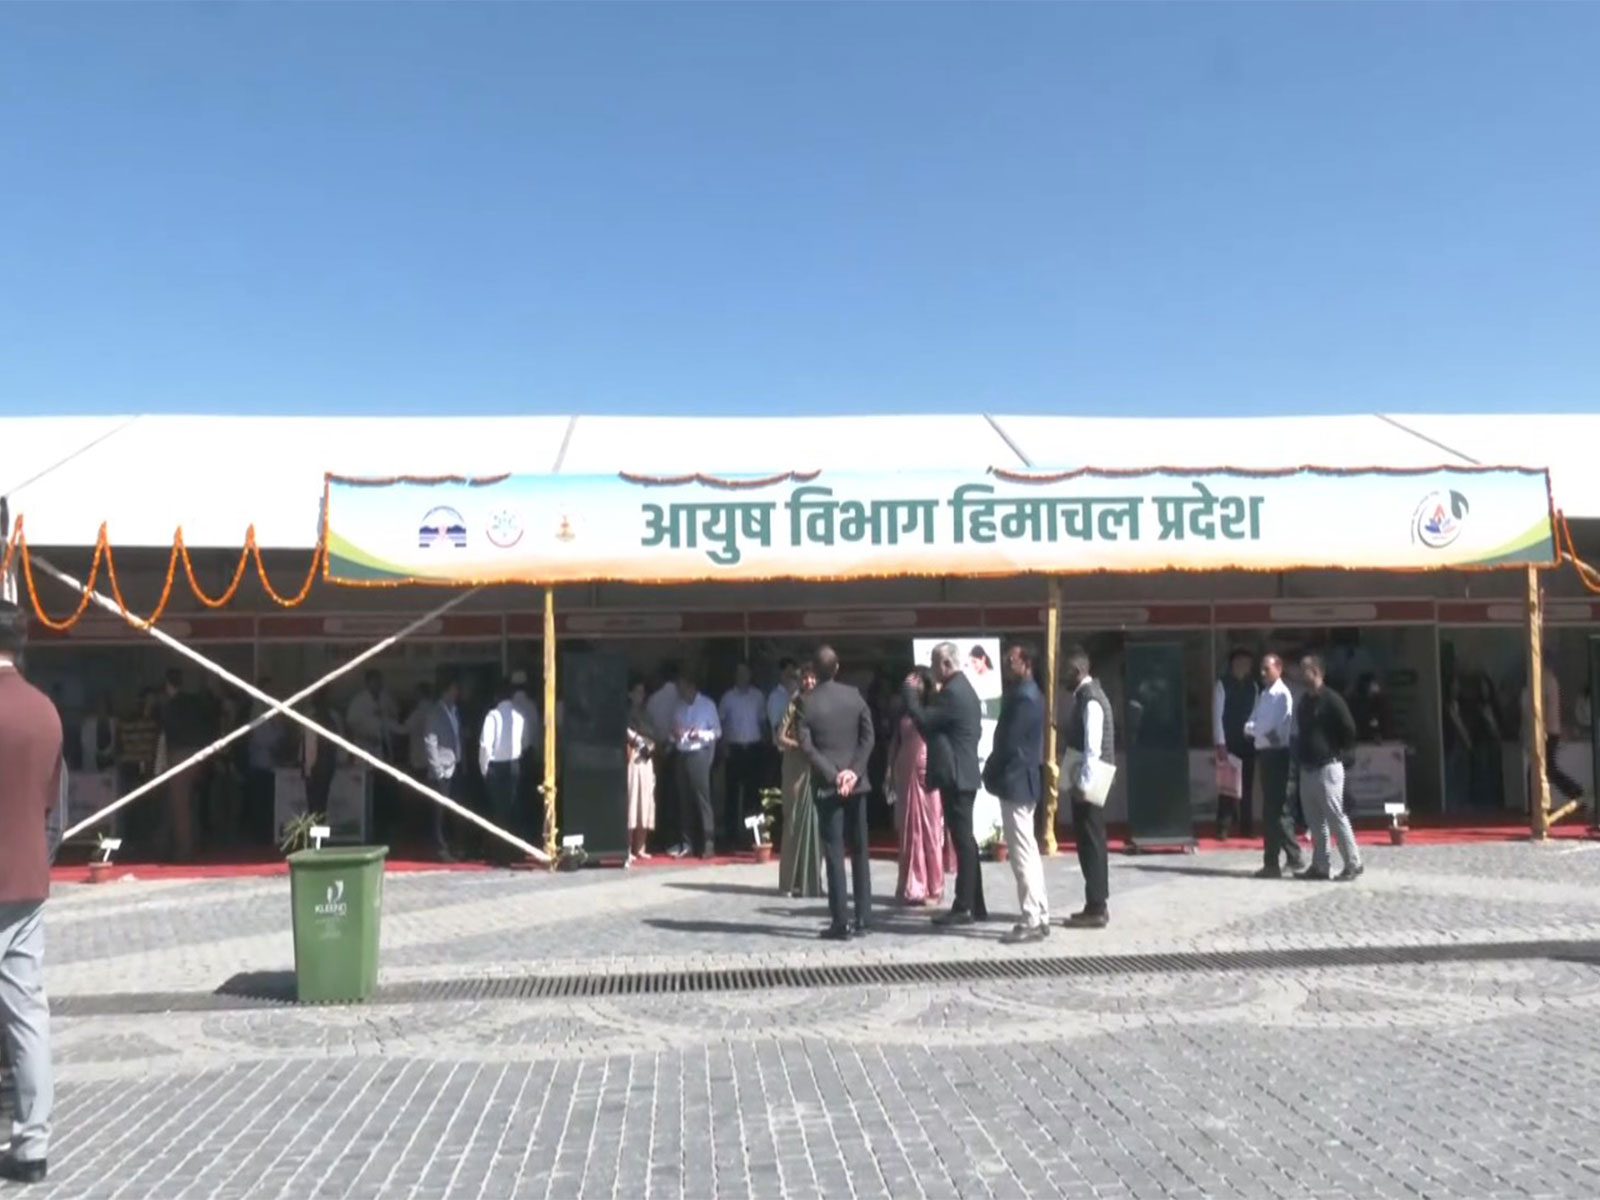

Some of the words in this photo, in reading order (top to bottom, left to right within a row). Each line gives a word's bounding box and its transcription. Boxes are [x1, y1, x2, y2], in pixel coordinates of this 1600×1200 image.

[641, 500, 776, 565] आयुष
[785, 486, 939, 546] विभाग
[948, 484, 1144, 544] हिमाचल
[1152, 482, 1265, 541] प्रदेश
